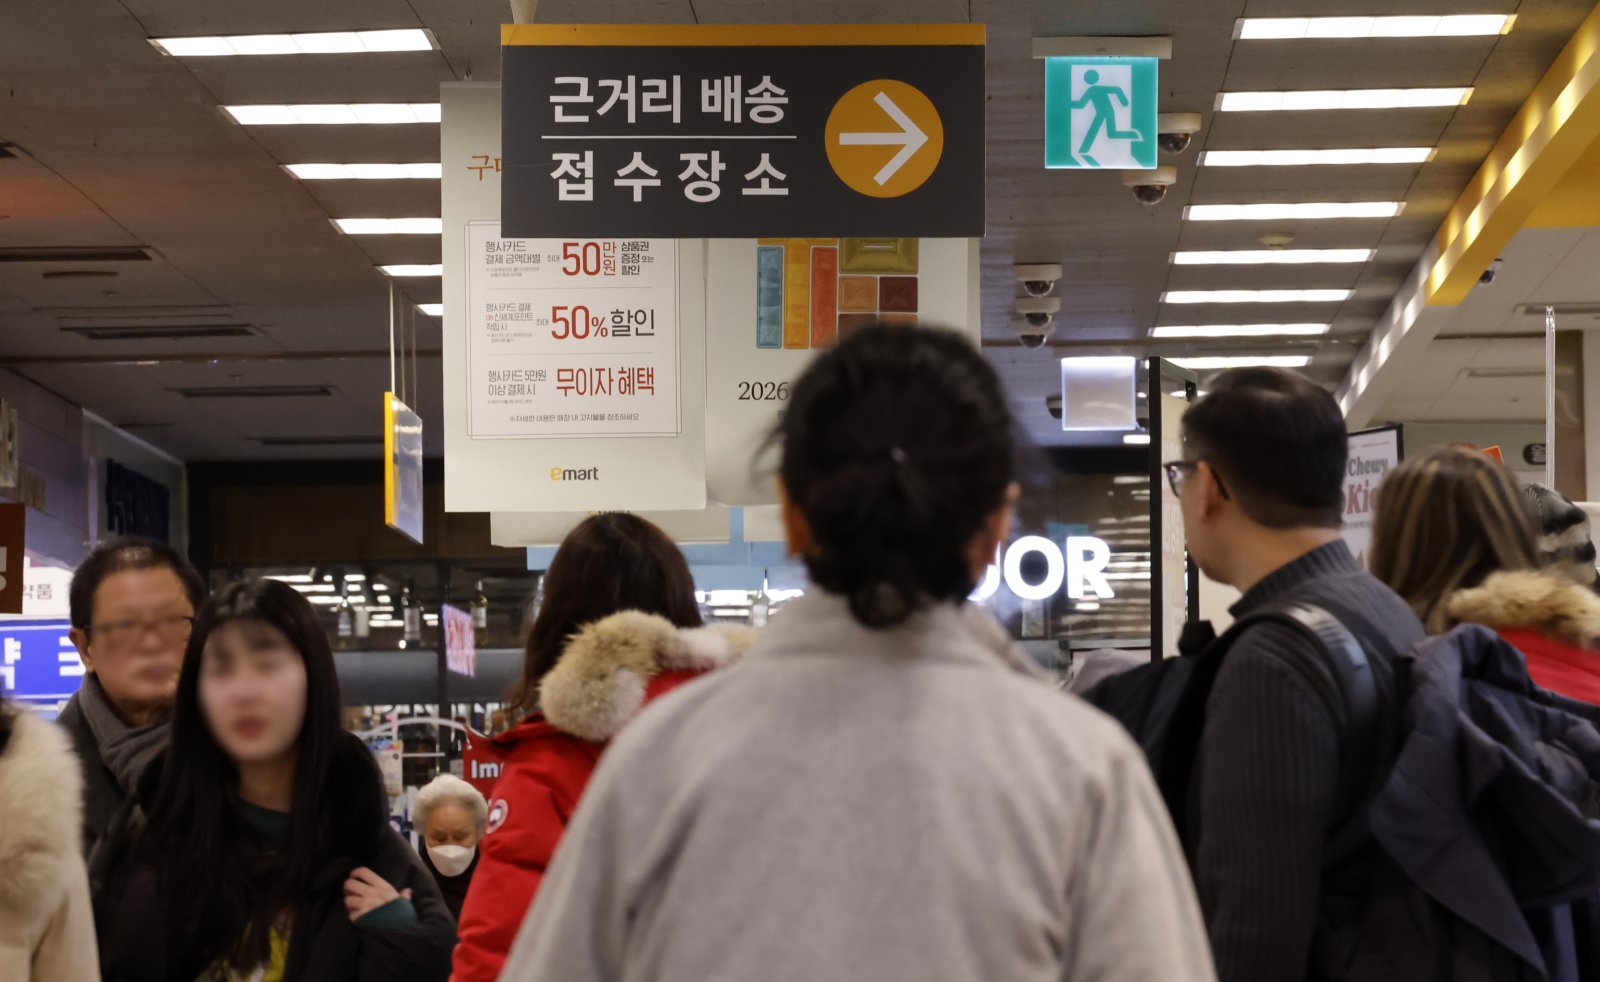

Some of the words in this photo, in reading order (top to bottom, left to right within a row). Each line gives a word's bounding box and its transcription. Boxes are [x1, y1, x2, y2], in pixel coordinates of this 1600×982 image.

[549, 74, 682, 124] 근거리
[702, 74, 789, 124] 배송
[485, 241, 526, 253] 행사카드
[621, 240, 650, 252] 상품권
[485, 253, 504, 265] 결제
[505, 252, 541, 265] 금액대별
[547, 254, 560, 263] 최대
[562, 241, 601, 276] 50
[621, 252, 640, 265] 증정
[641, 255, 655, 264] 또는
[621, 264, 640, 276] 할인
[486, 302, 517, 313] 행사카드
[518, 302, 531, 312] 결제
[494, 312, 533, 322] 신세계포인트
[536, 318, 549, 327] 최대
[486, 322, 500, 332] 적립
[500, 322, 508, 332] 시
[488, 369, 523, 382] 행사카드
[524, 369, 547, 382] 5만원
[556, 367, 614, 397] 무이자
[617, 367, 655, 396] 혜택
[488, 384, 506, 396] 이상
[507, 384, 525, 396] 결제
[526, 384, 536, 396] 시
[738, 381, 789, 401] 2026
[1347, 456, 1389, 477] Chewy
[550, 466, 600, 481] emart
[471, 759, 504, 779] Im
